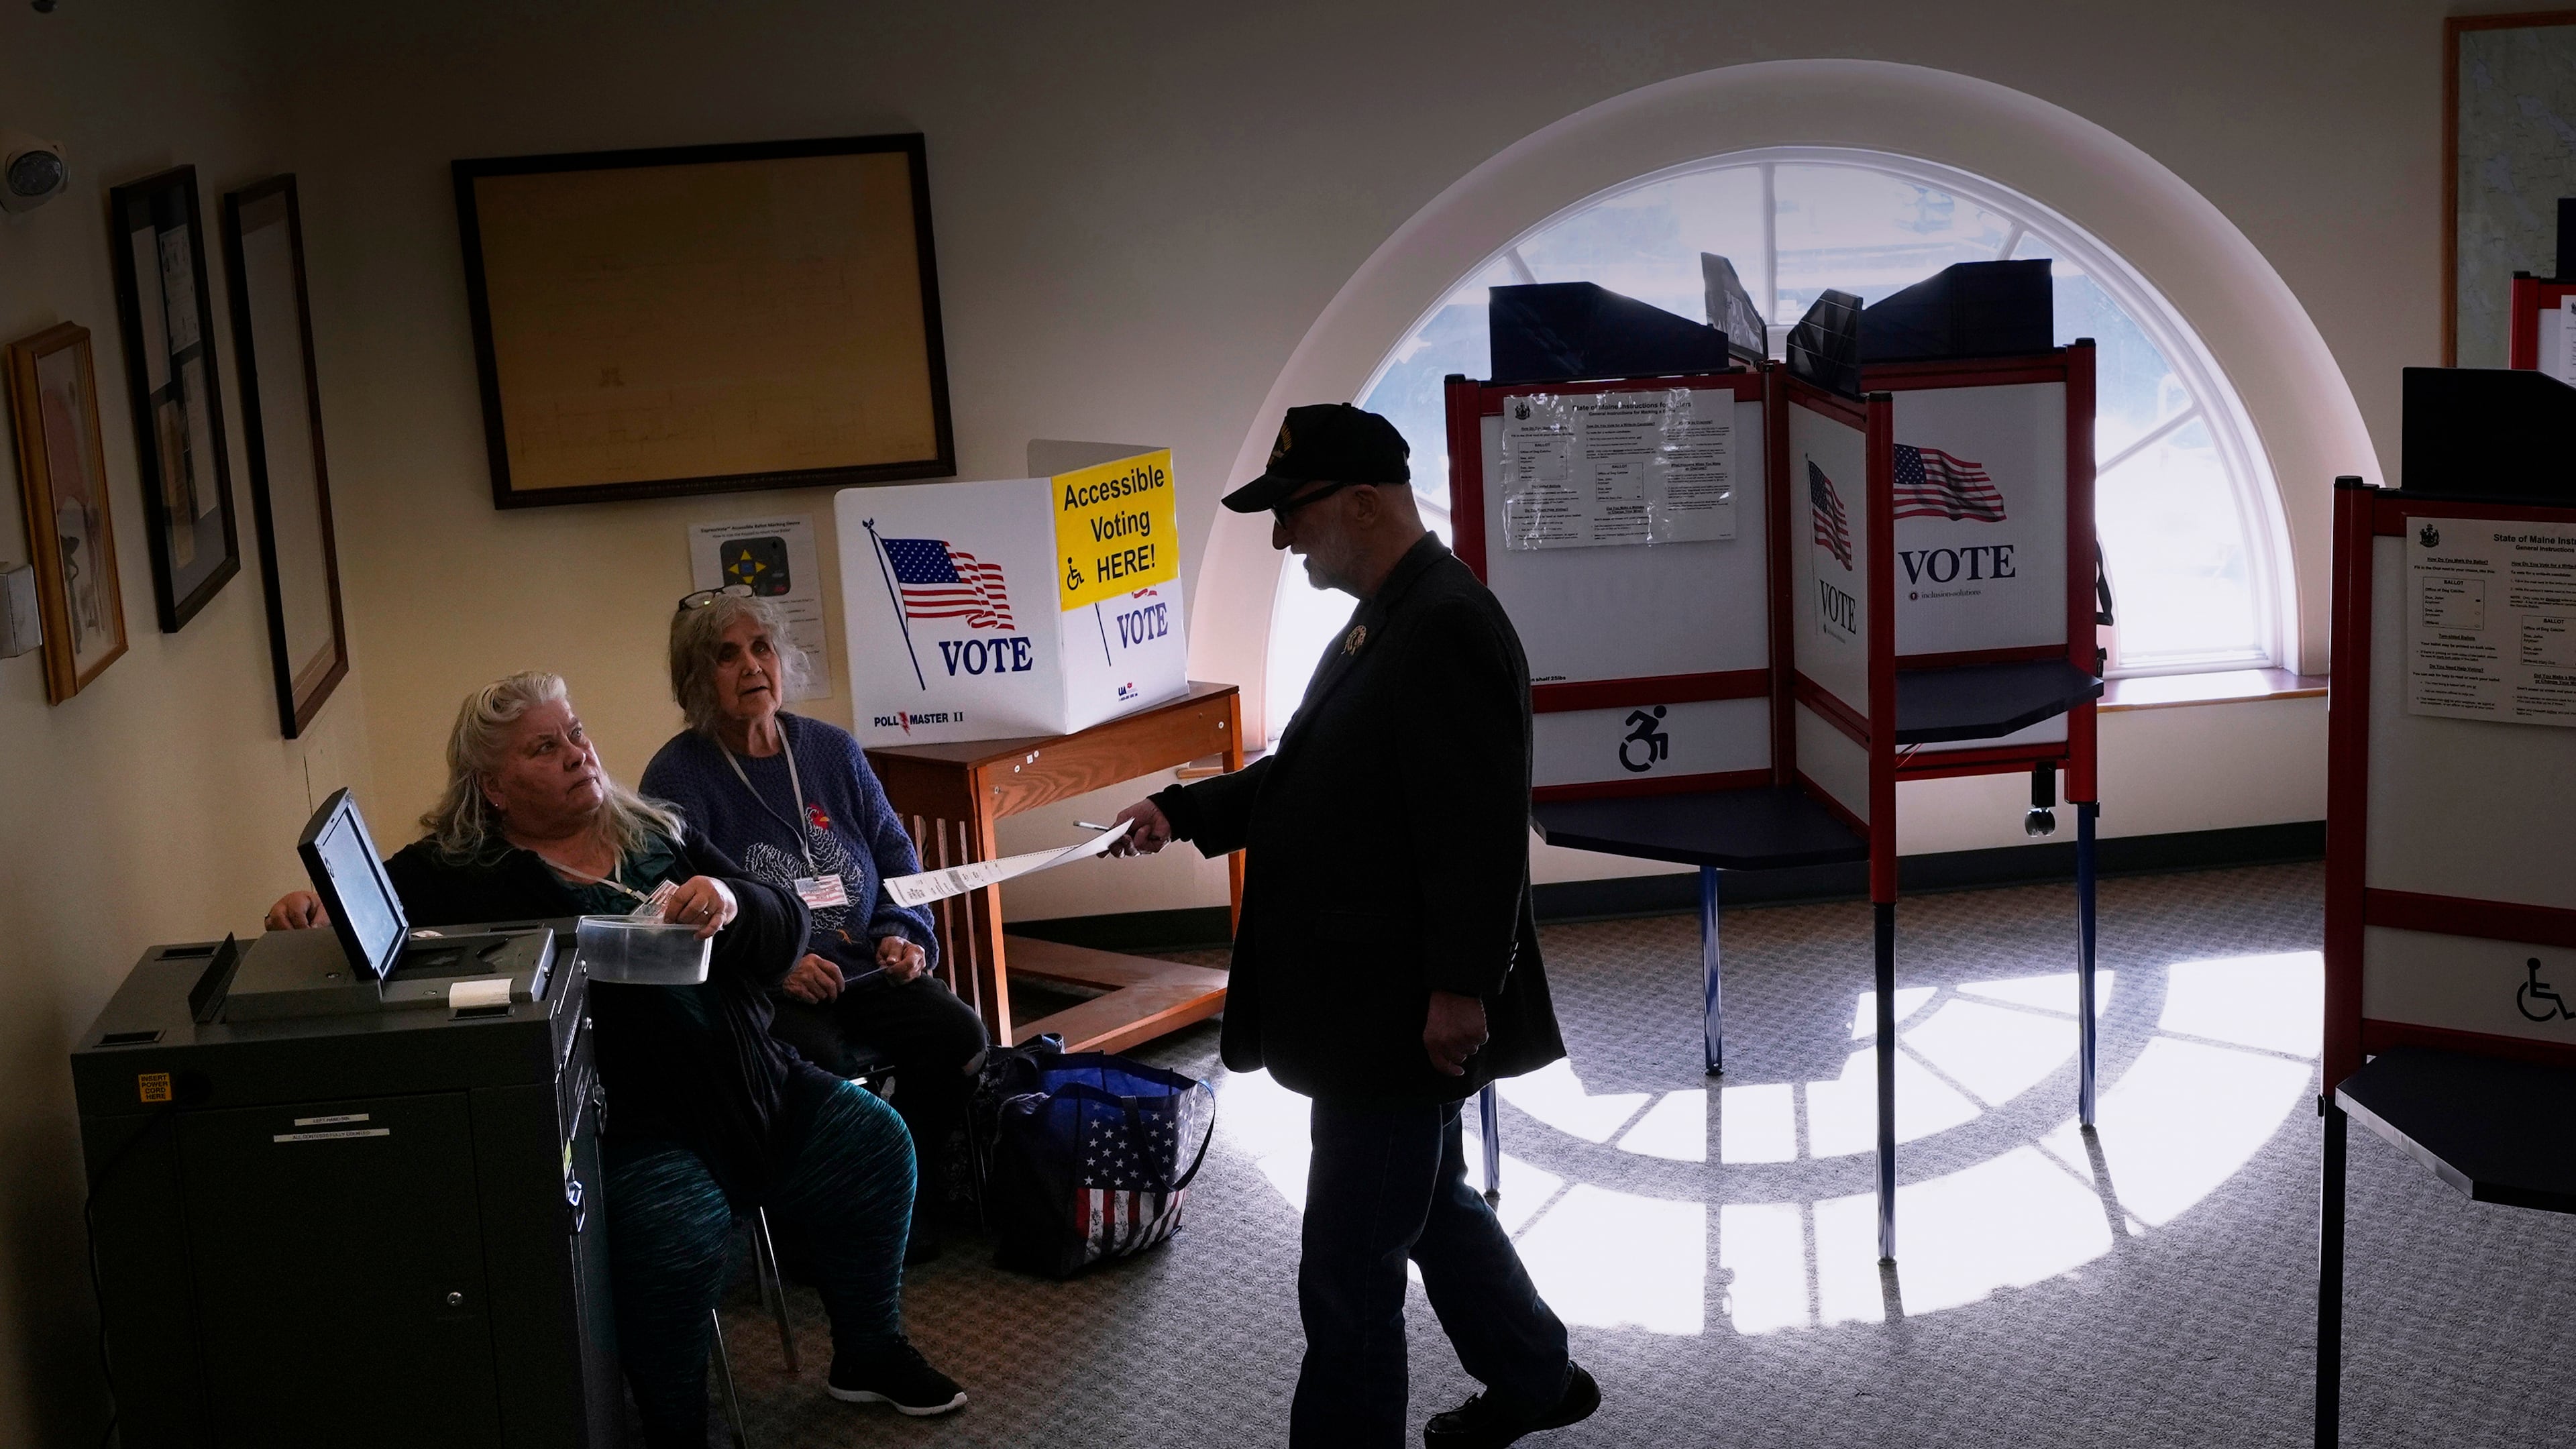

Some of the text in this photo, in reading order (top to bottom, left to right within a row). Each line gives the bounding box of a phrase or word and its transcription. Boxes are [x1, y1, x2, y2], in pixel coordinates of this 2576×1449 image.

[1064, 464, 1165, 511] Accessible
[1090, 511, 1150, 542] Voting
[2493, 533, 2516, 542] State
[2529, 535, 2555, 544] Maine
[1097, 543, 1155, 583] HERE!
[1898, 545, 2016, 585] VOTE
[1116, 602, 1169, 649] VOTE
[1819, 578, 1856, 635] VOTE
[938, 637, 1033, 676] VOTE
[874, 712, 963, 727] POLL MASTER II
